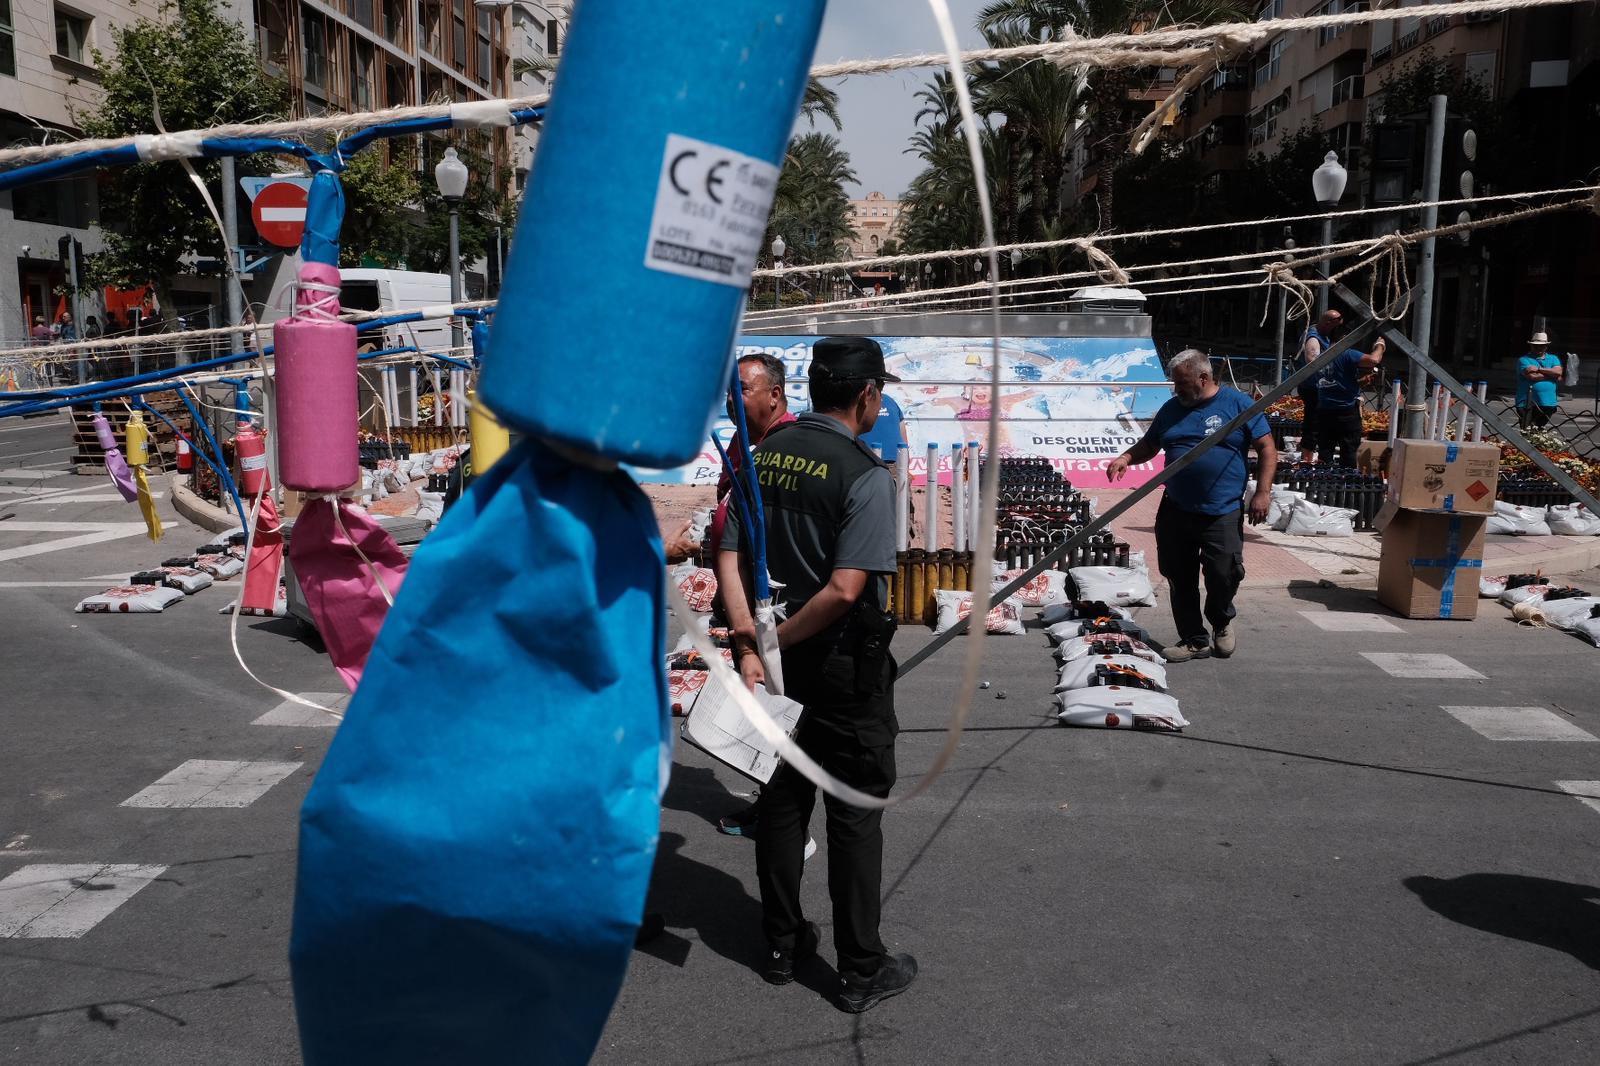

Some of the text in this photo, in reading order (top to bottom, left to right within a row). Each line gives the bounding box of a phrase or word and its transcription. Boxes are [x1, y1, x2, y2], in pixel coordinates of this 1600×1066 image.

[669, 149, 730, 204] CE
[1032, 436, 1141, 446] DESCUENTO
[1066, 446, 1119, 454] ONLINE
[752, 451, 829, 480] GUARDIA
[758, 469, 799, 491] CIVIL
